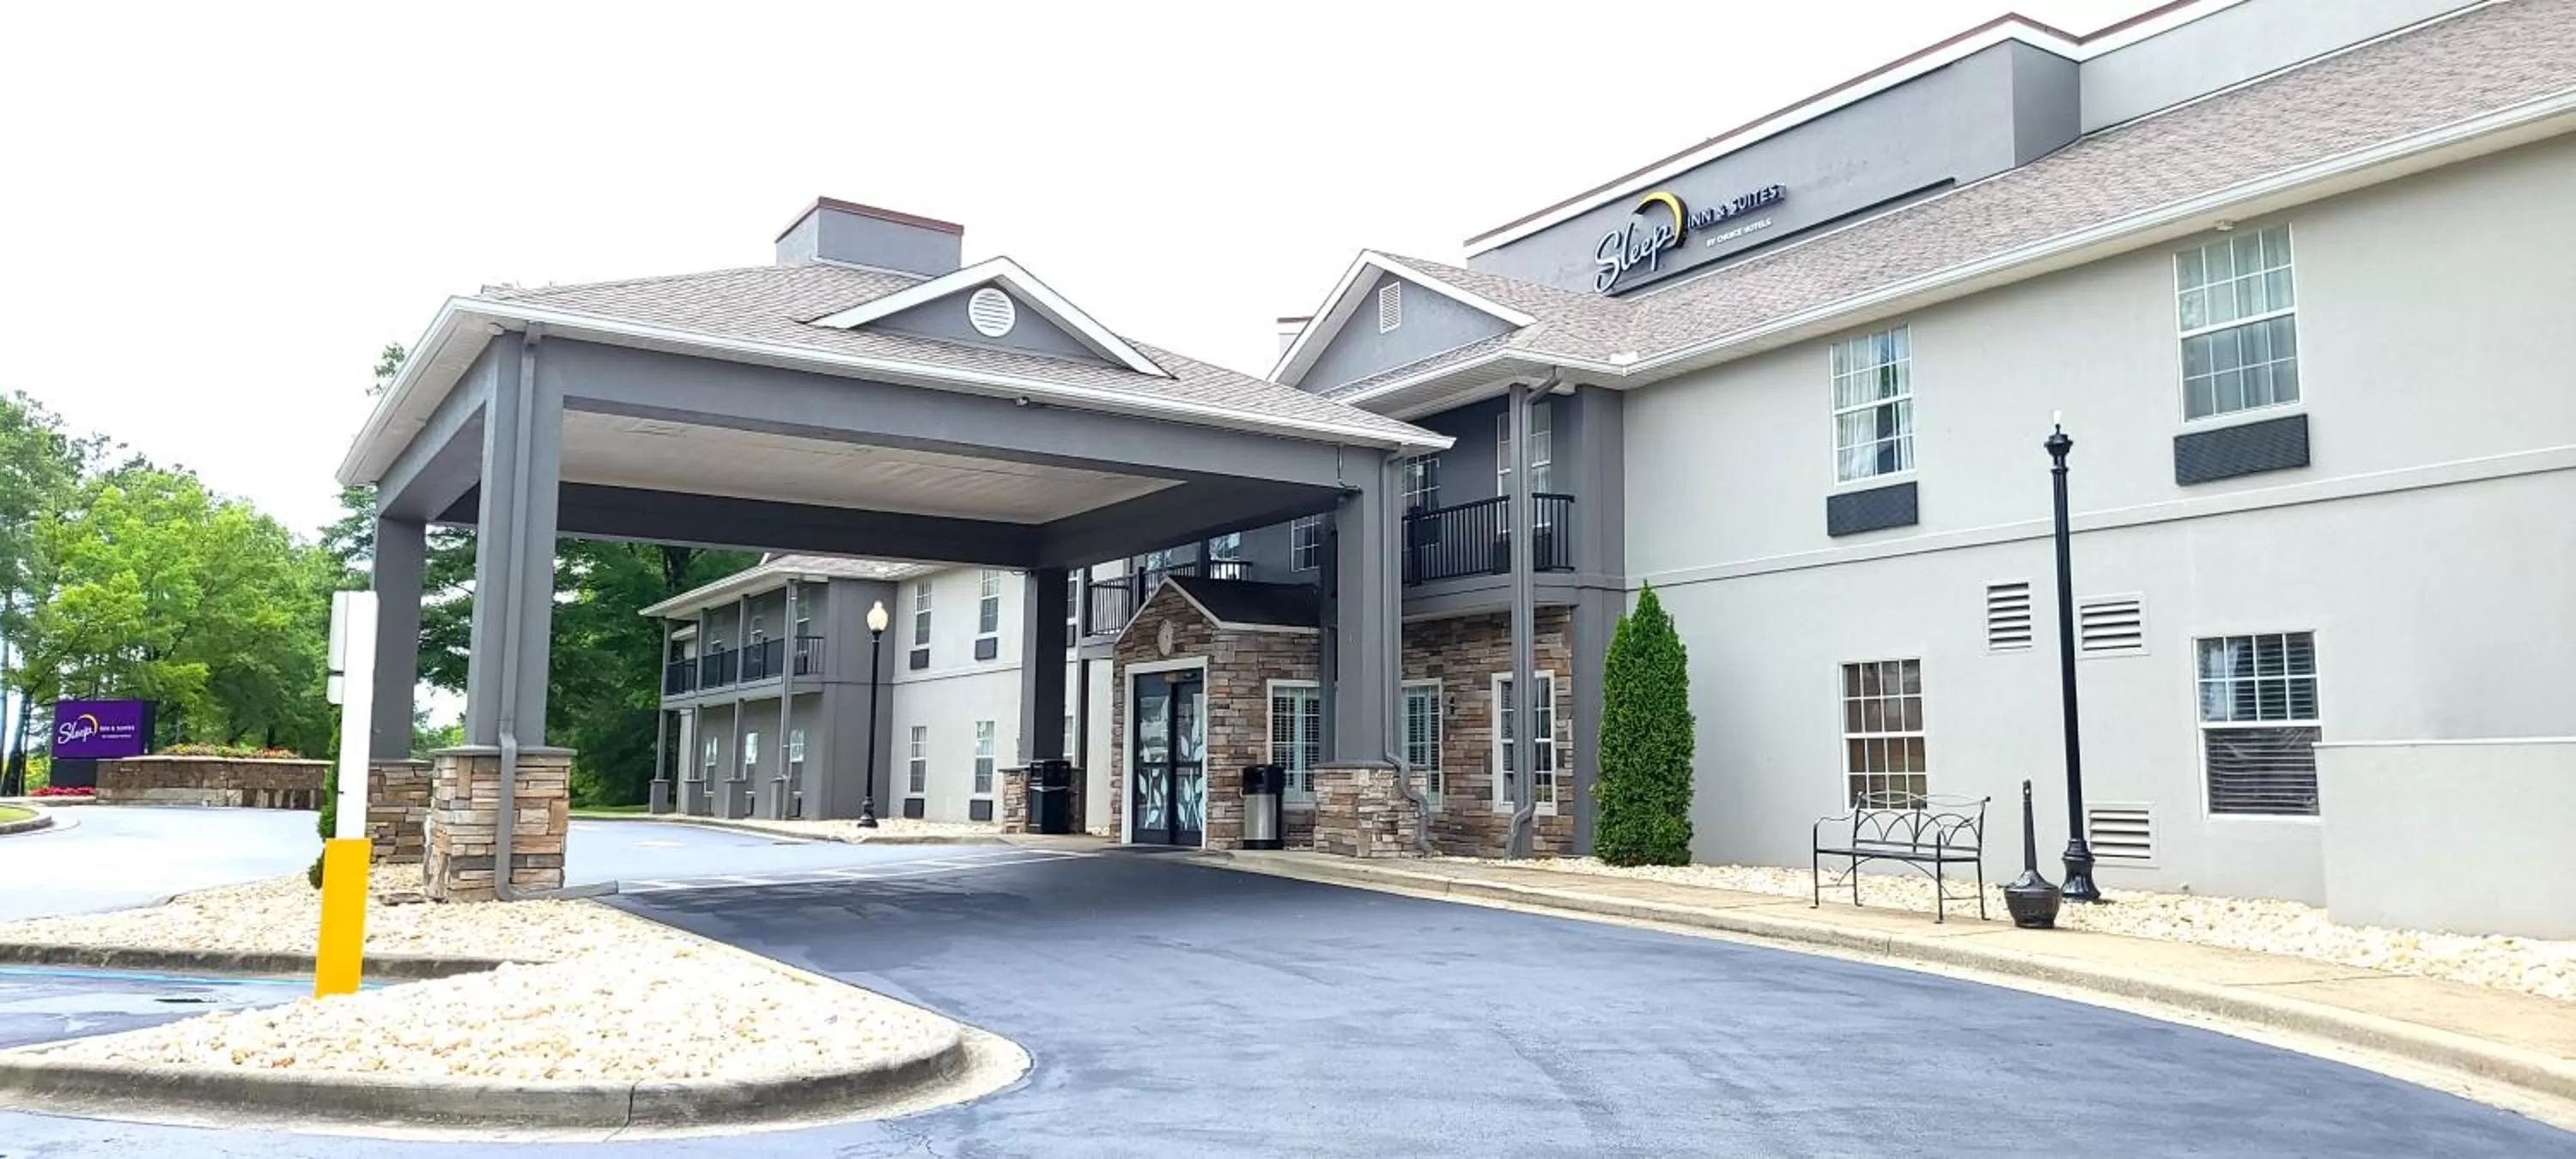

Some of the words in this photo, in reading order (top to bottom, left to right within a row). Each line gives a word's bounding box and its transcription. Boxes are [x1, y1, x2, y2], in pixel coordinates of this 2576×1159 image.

[1687, 207, 1714, 229] INN
[1729, 183, 1785, 215] SUITES
[1594, 219, 1674, 293] Sleep
[58, 721, 94, 744] Sleep
